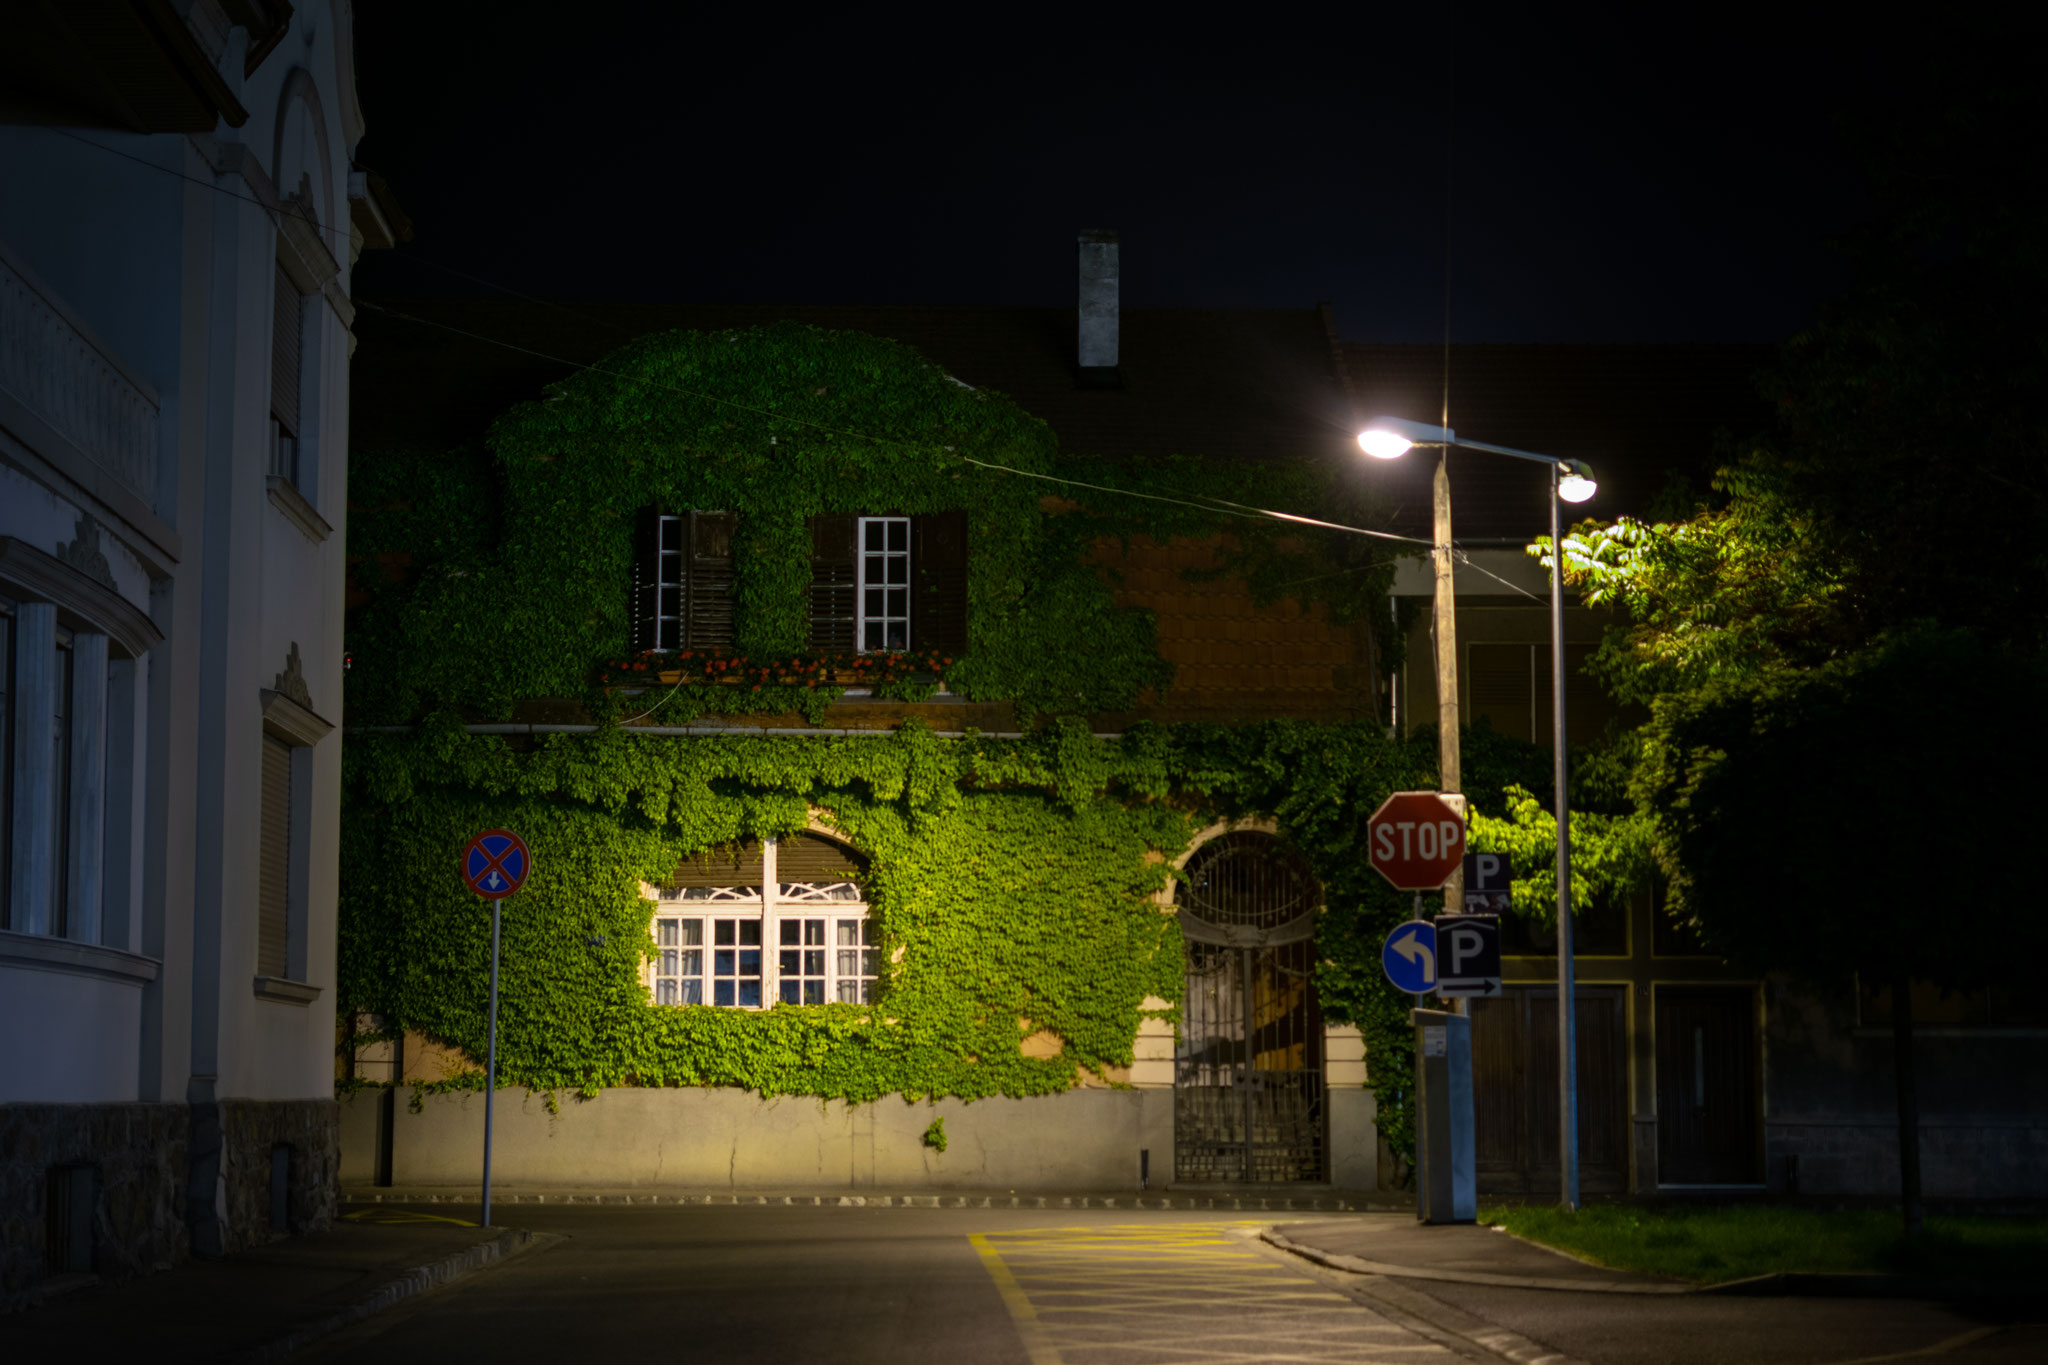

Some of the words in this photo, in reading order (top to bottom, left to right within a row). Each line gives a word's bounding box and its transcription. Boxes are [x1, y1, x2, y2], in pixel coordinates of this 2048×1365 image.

[1376, 820, 1459, 862] STOP
[1476, 854, 1500, 889] P
[1451, 929, 1484, 975] P
